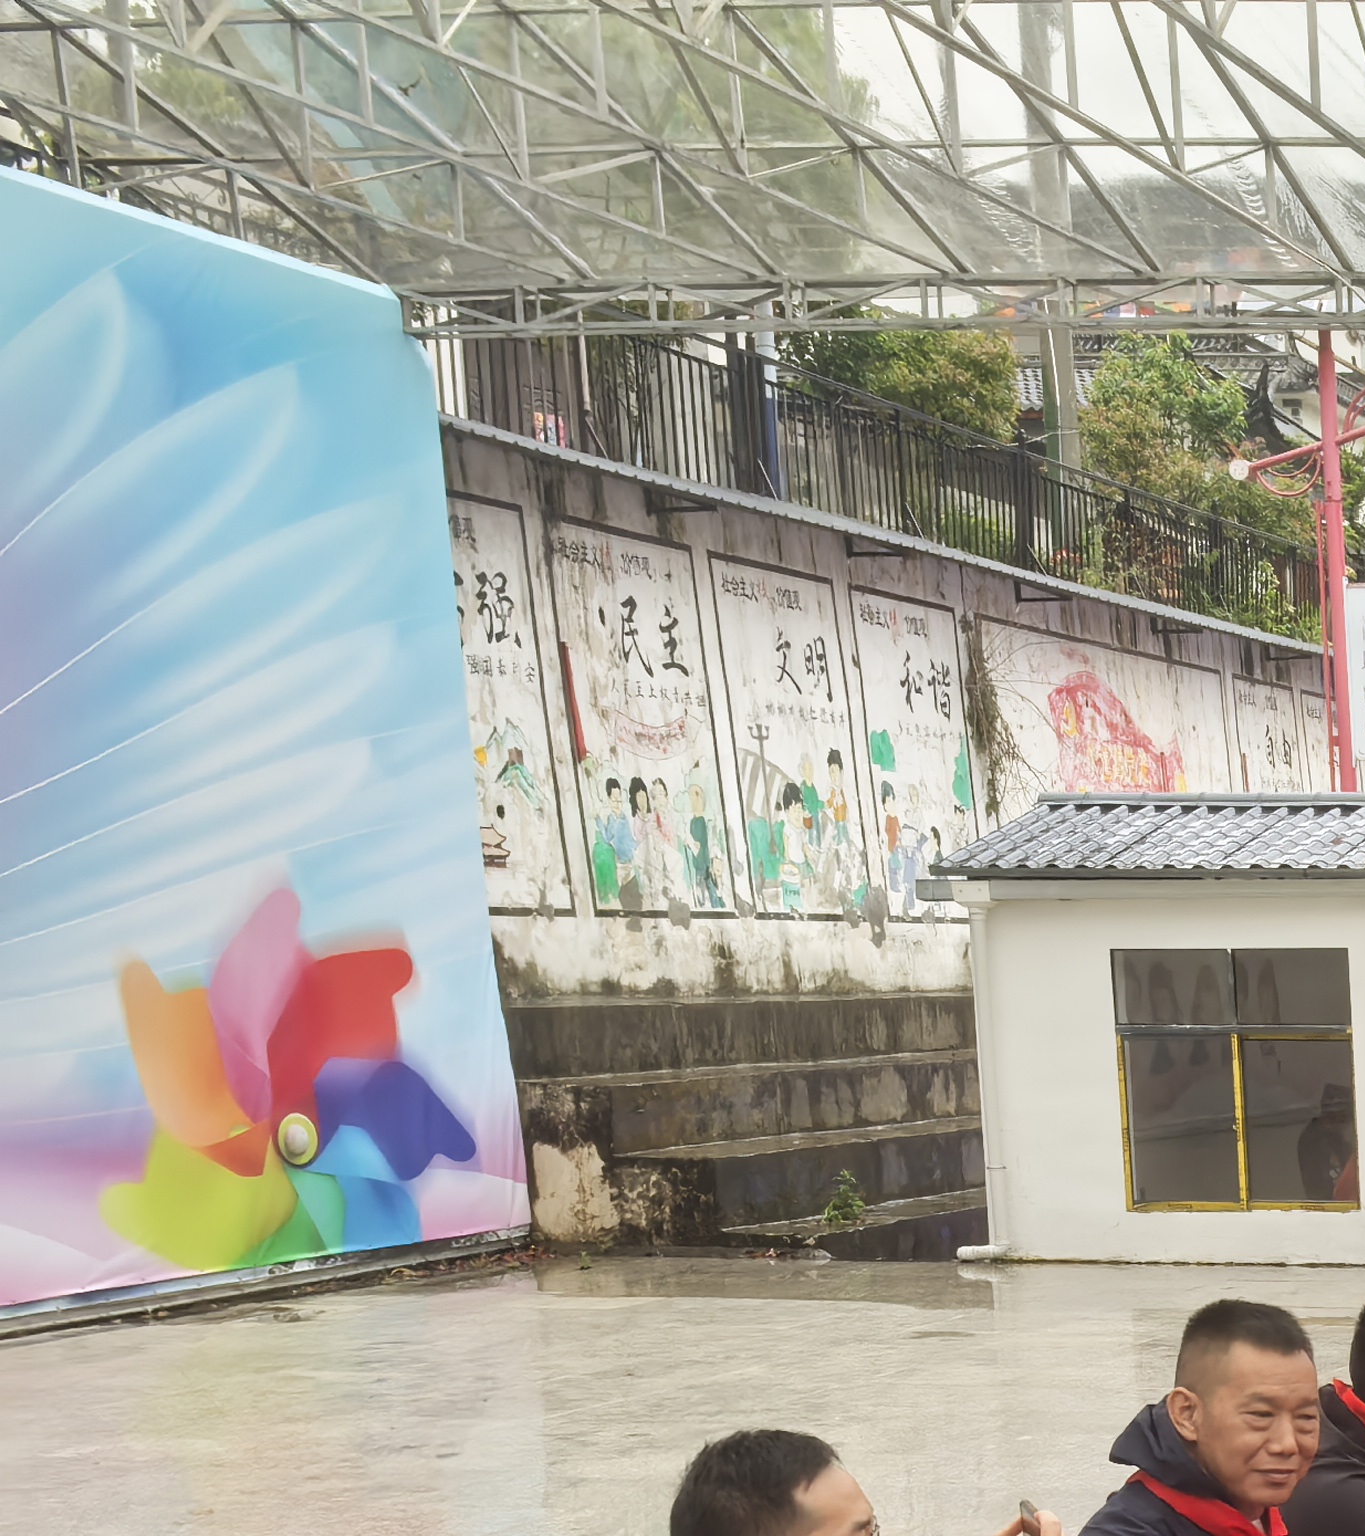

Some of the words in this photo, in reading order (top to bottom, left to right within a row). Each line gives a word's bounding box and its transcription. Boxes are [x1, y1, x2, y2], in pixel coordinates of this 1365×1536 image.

[721, 571, 803, 613] 社会主义核价值观
[619, 595, 690, 679] 民主
[775, 626, 833, 703] 文明
[900, 650, 951, 723] 和谐
